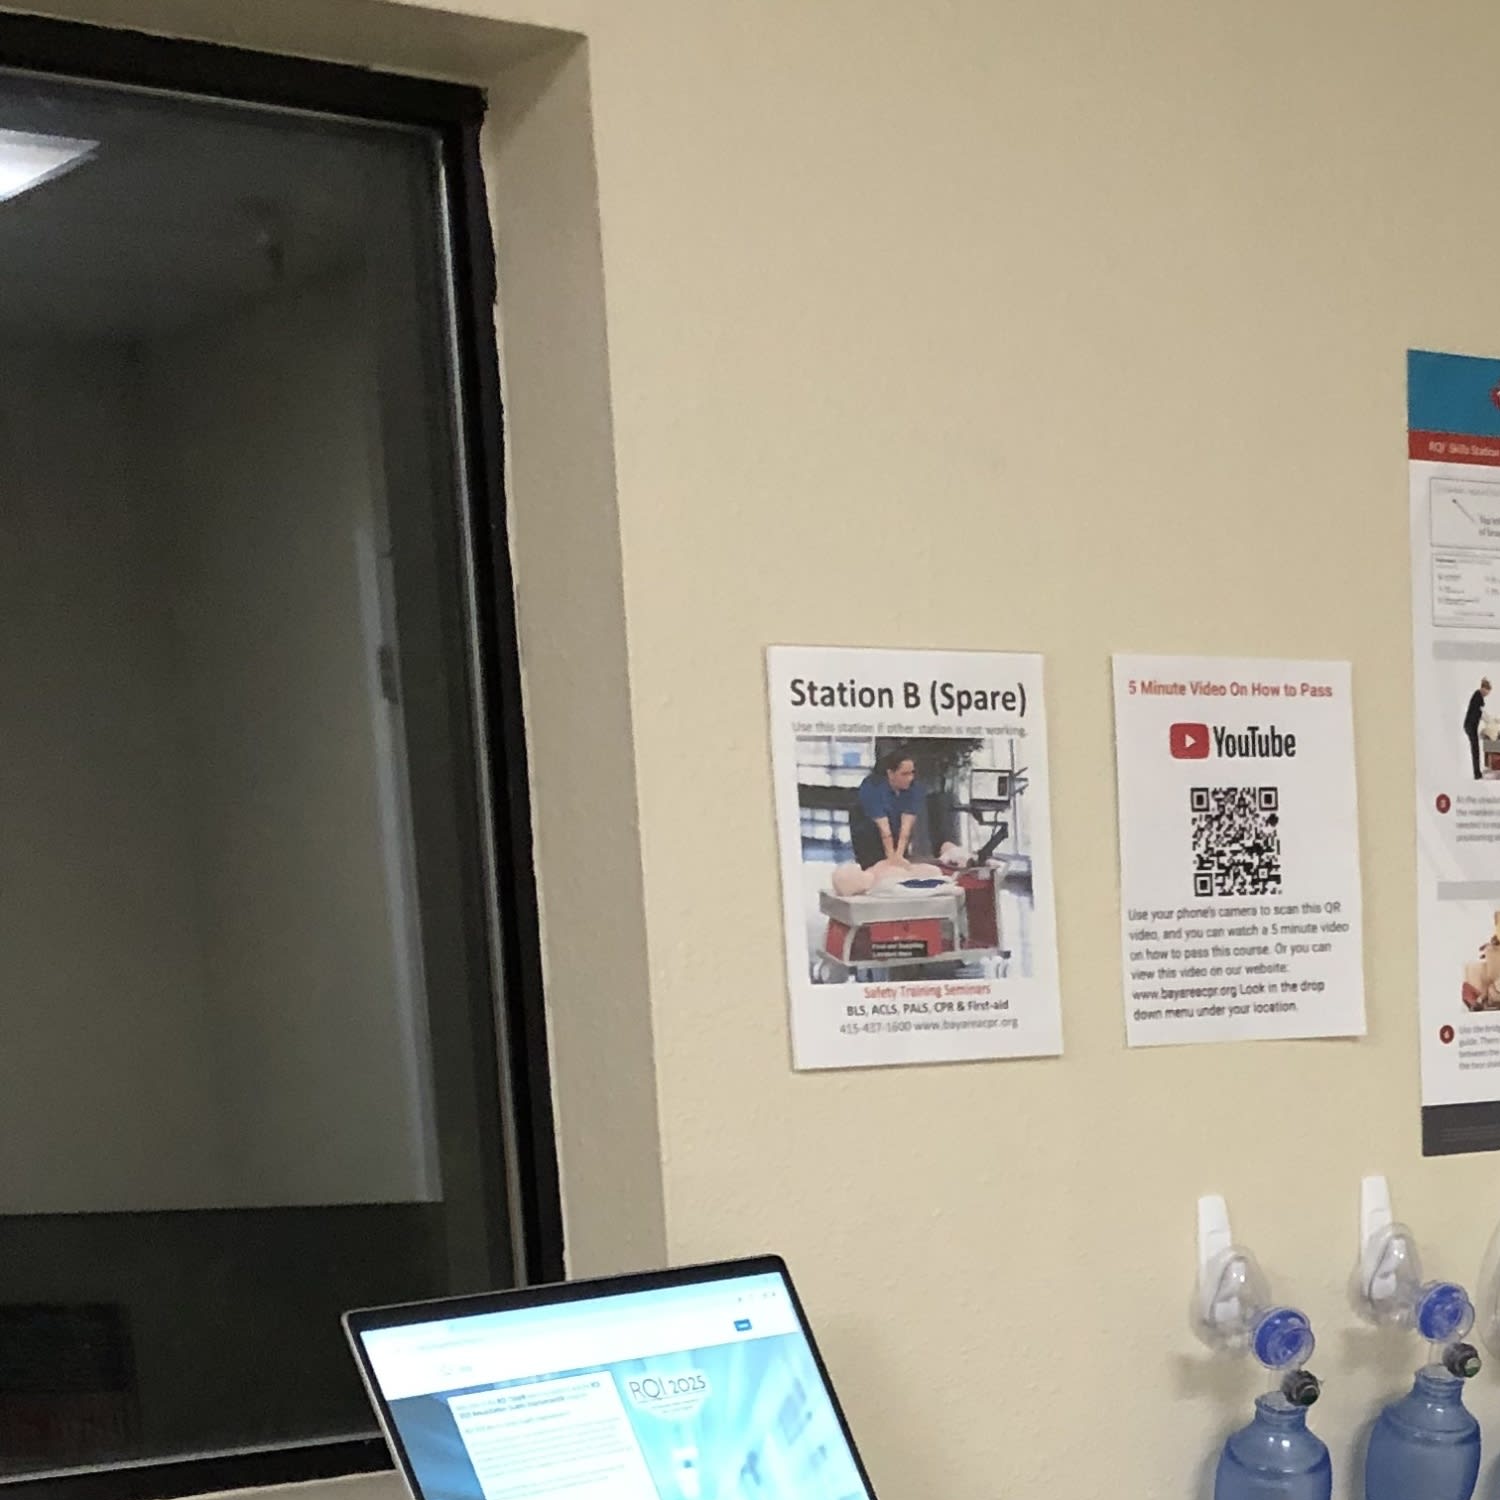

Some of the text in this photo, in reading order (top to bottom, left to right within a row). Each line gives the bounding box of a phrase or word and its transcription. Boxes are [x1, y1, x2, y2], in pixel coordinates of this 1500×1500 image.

[1470, 445, 1500, 457] Station
[790, 678, 1026, 717] Station B (Spare)
[1129, 680, 1333, 697] 5 Minute Video On How to Pass
[816, 721, 835, 733] this
[837, 722, 873, 733] station
[918, 723, 953, 735] station
[1213, 725, 1296, 758] YouTube
[1128, 901, 1342, 922] Use your phone's camera to scan this QR
[1129, 921, 1349, 942] video, and you can watch a 5 minute video
[1130, 952, 1143, 961] on
[1146, 949, 1168, 961] how
[1171, 949, 1181, 960] to
[1184, 949, 1209, 962] pass
[1211, 946, 1231, 957] this
[1274, 943, 1287, 954] Or
[1290, 944, 1309, 956] you
[1312, 943, 1332, 953] can
[1131, 969, 1155, 980] view
[1157, 967, 1177, 978] this
[1180, 966, 1207, 978] video
[1209, 966, 1222, 976] on
[1225, 966, 1241, 975] our
[864, 983, 991, 1000] Safety Training Seminars
[1132, 980, 1325, 999] www.bayareacpr.org Look in the drop
[847, 999, 1009, 1018] BLS, ACLS, PALS, CPR & First-aid
[1133, 1009, 1162, 1021] down
[1165, 1008, 1194, 1018] menu
[1196, 1005, 1225, 1017] under
[1228, 1004, 1250, 1017] your
[629, 1375, 706, 1401] RQI 2025
